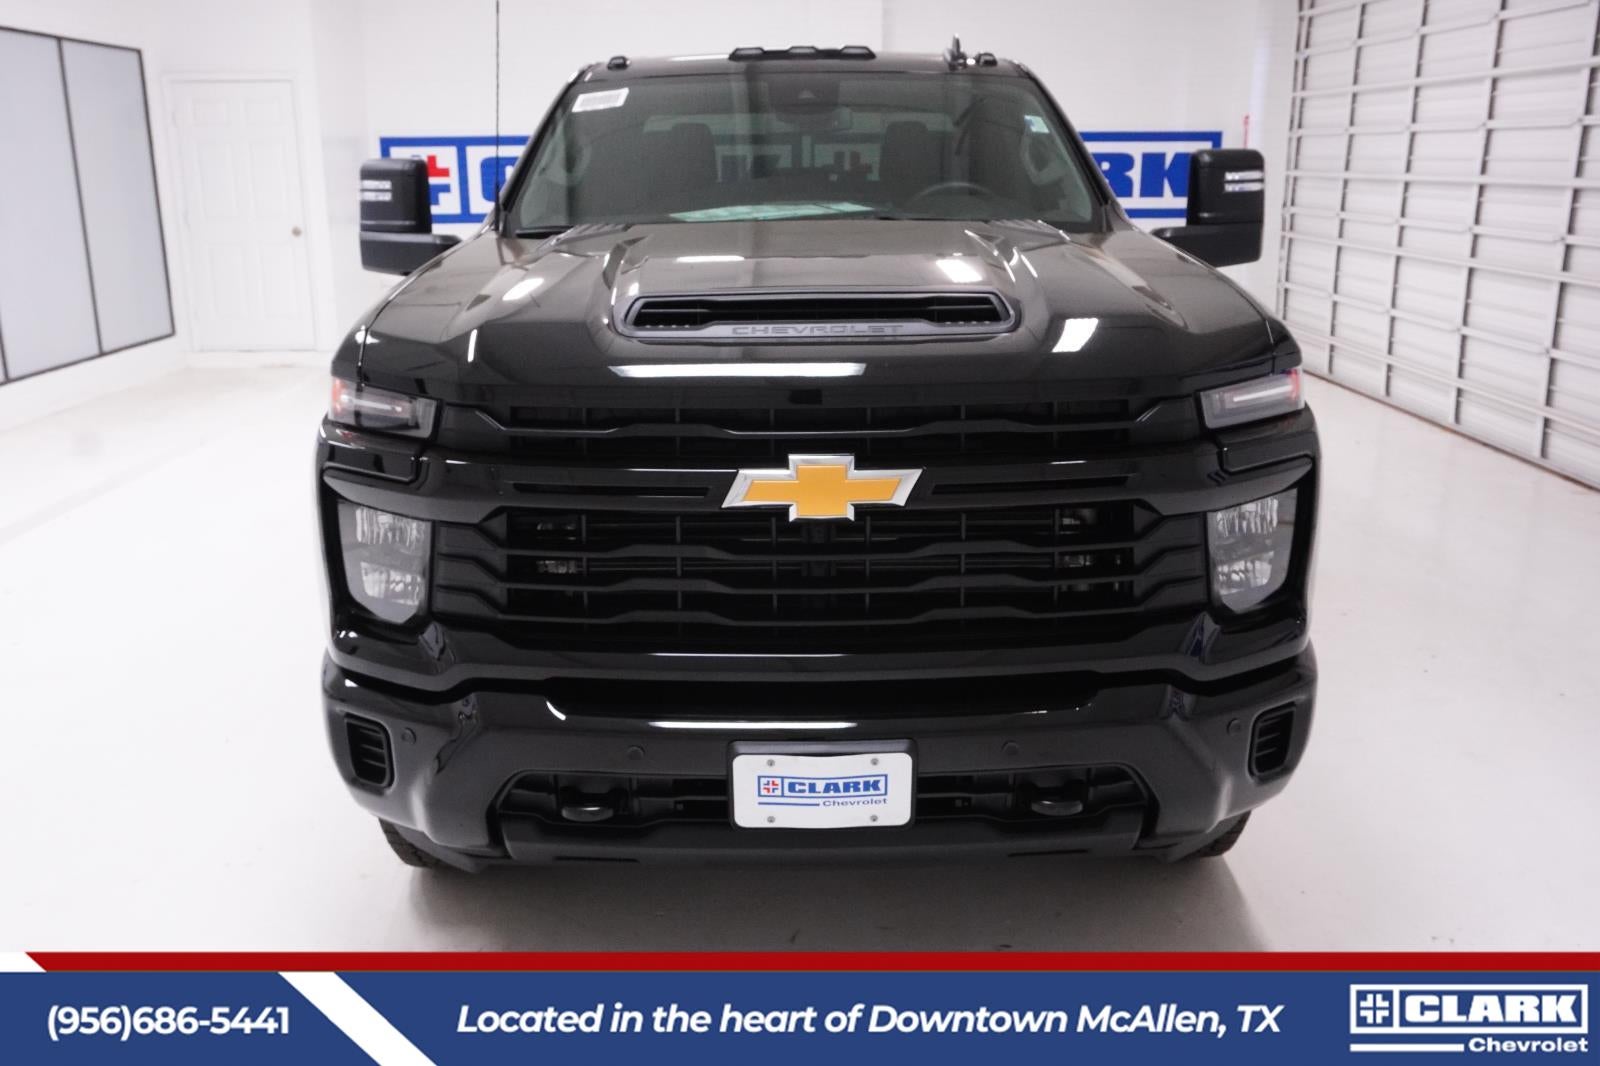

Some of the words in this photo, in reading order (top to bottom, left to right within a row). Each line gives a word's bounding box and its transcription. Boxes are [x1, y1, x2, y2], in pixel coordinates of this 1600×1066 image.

[731, 324, 905, 335] CHEVROLET
[787, 779, 881, 794] CLARK
[822, 797, 888, 807] Chevrolet
